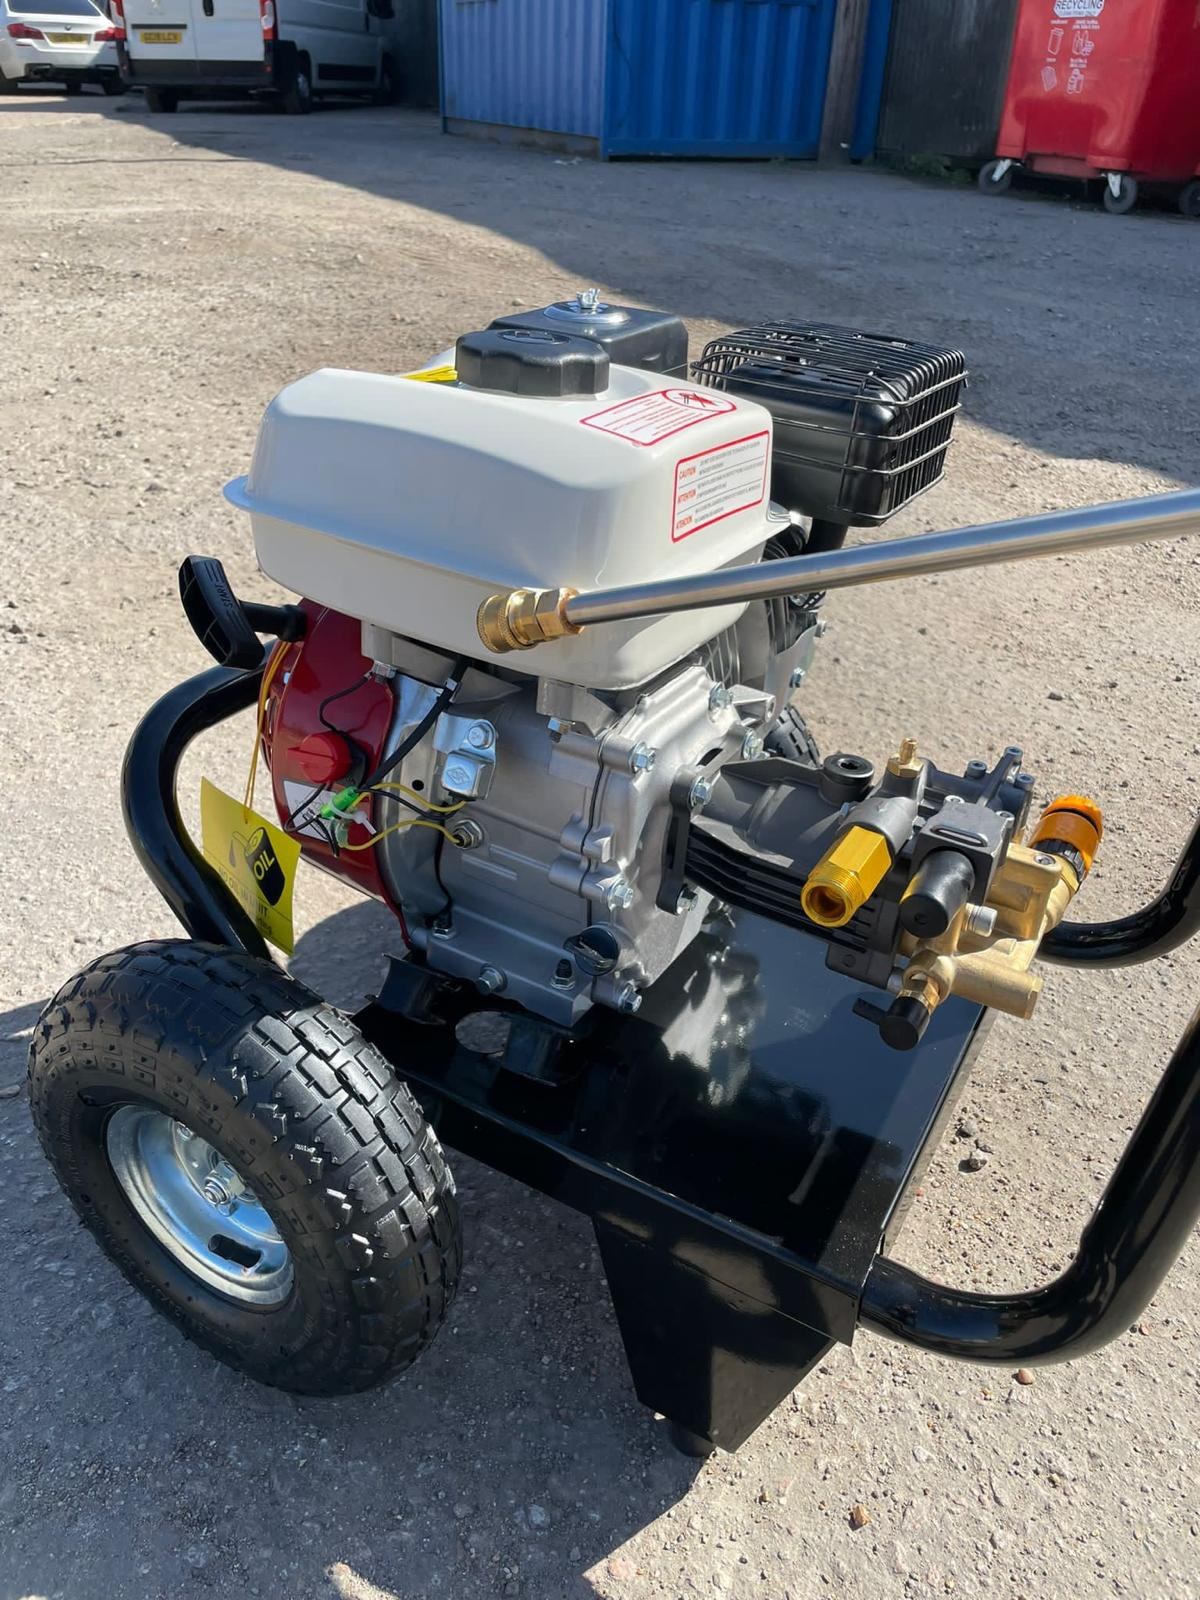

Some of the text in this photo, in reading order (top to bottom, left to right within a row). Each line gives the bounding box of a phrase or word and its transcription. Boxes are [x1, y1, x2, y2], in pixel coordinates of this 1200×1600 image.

[1056, 0, 1103, 10] RECYCLING
[679, 467, 696, 480] CAUTION
[215, 583, 233, 608] START
[253, 850, 275, 881] OIL
